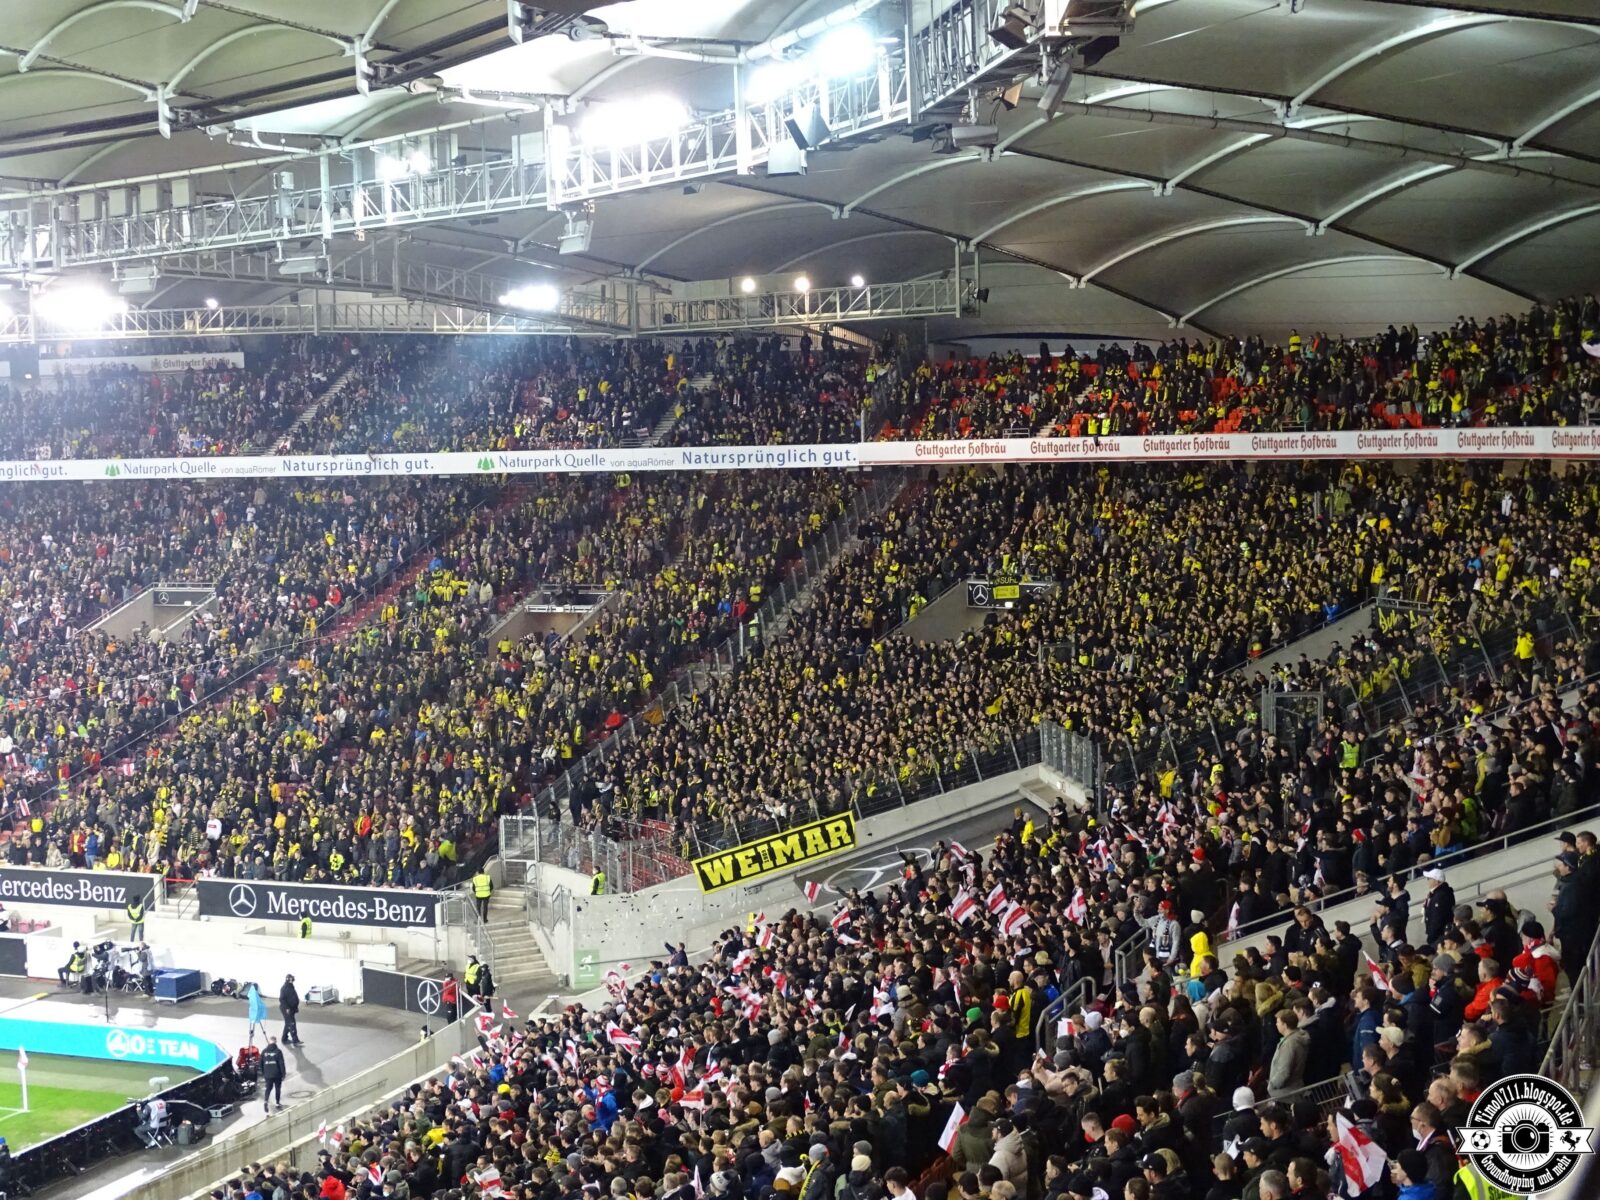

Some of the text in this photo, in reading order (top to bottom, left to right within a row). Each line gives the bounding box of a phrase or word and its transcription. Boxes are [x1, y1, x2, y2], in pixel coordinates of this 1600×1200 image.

[1030, 440, 1080, 456] Stuttgarter
[1143, 436, 1230, 454] Stuttgarter Hofbräu
[1251, 434, 1337, 452] Stuttgarter Hofbräu
[1357, 431, 1438, 451] Stuttgarter Hofbräu
[1457, 430, 1535, 450] Stuttgarter Hofbräu
[915, 442, 1006, 458] Stuttgarter Hofbräu
[123, 461, 178, 476] Naturpark
[180, 461, 217, 474] Quelle
[404, 458, 434, 473] gut.
[499, 454, 561, 471] Naturpark
[564, 453, 606, 467] Quelle
[682, 449, 817, 467] Natursprünglich
[822, 449, 857, 465] gut.
[42, 465, 68, 478] gut.
[701, 819, 853, 887] WEIMAR
[0, 877, 126, 904] ercedes-Benz
[267, 891, 427, 923] Mercedes-Benz
